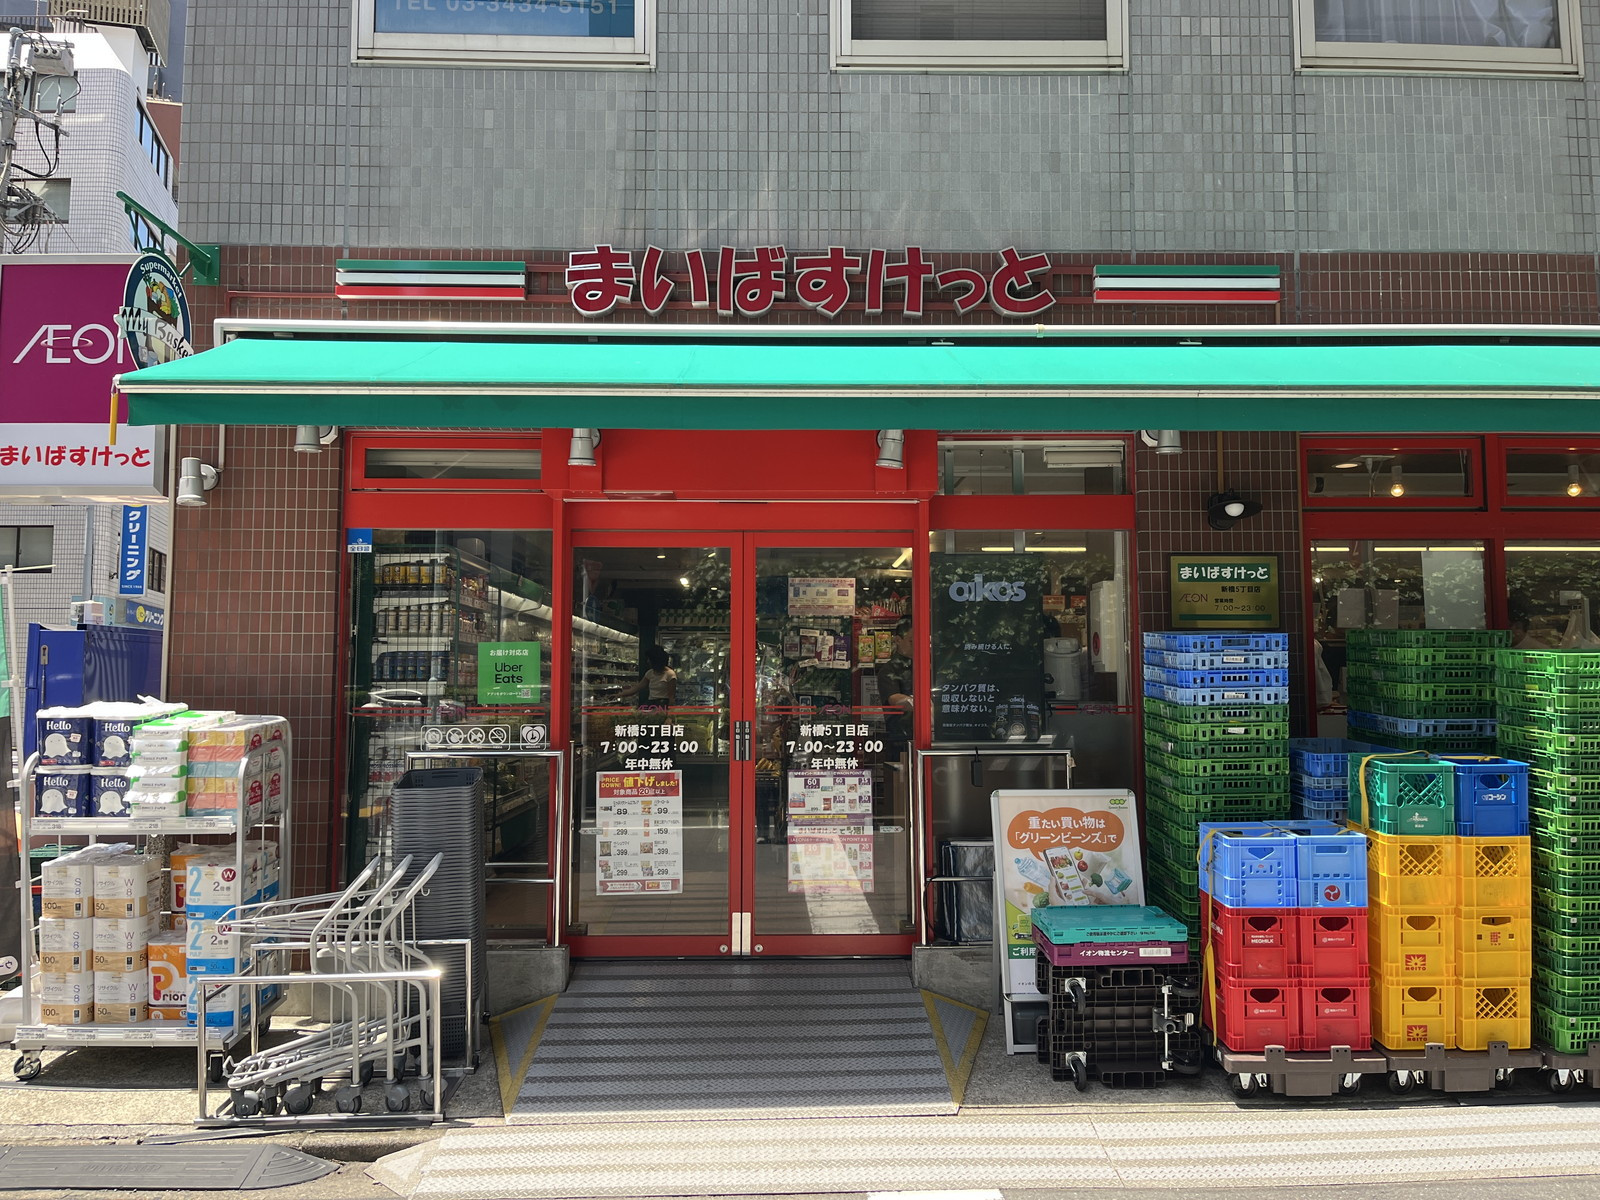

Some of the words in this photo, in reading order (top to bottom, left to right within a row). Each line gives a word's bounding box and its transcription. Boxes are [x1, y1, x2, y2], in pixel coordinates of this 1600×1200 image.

[140, 261, 183, 299] Supermarket
[565, 245, 1056, 317] まいばすけっと
[121, 307, 149, 336] My
[154, 320, 193, 358] Baske
[0, 445, 151, 467] まいばすけっと
[126, 511, 142, 580] クリーニング
[1180, 566, 1269, 579] まいばすけっと
[949, 574, 1027, 602] oikos
[495, 663, 523, 672] Uber
[495, 674, 523, 684] Eats
[942, 684, 1000, 692] タンパク質は、
[941, 694, 995, 703] 吸収しないと
[941, 705, 992, 713] 意味がない。
[46, 720, 71, 730] Hello
[105, 722, 130, 732] Hello
[614, 724, 685, 737] 新橋5丁目店
[800, 724, 869, 737] 新橋5丁目店
[625, 758, 673, 770] 年中無休
[811, 757, 859, 770] 年中無休
[43, 776, 69, 786] Hello
[101, 778, 127, 788] Hello
[1028, 816, 1105, 829] 重たい買い物は
[1015, 832, 1117, 844] 「グリーンビーンズ」で
[75, 878, 81, 886] S
[125, 878, 134, 886] W
[190, 867, 202, 896] 2
[190, 921, 202, 950] 2
[73, 941, 79, 949] 8
[1013, 947, 1036, 956] ご利用
[74, 985, 80, 993] S
[128, 983, 138, 991] W
[74, 994, 79, 1002] 8
[130, 993, 136, 1001] 8
